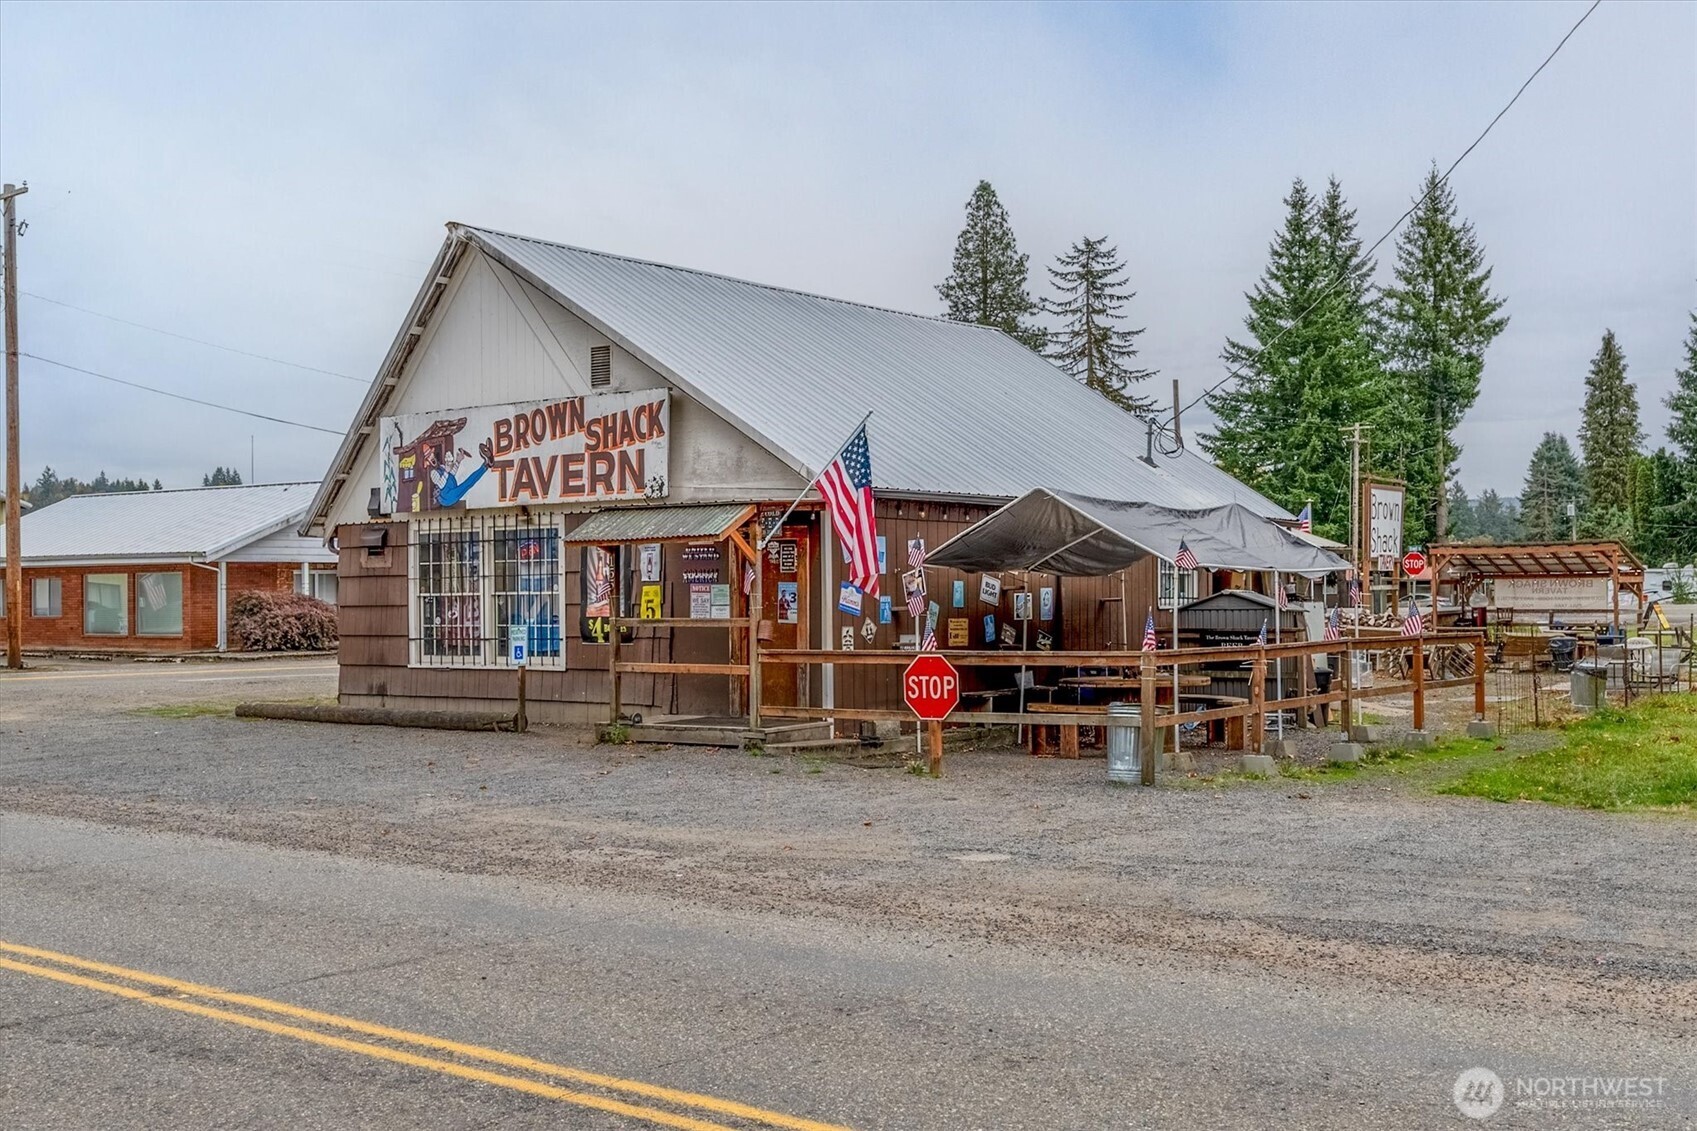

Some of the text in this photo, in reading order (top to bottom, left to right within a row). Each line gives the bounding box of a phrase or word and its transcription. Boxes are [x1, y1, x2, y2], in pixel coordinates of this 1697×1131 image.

[493, 397, 666, 457] BROWN SHACK
[491, 449, 646, 503] TAVERN
[1371, 494, 1400, 522] Brown
[1371, 527, 1399, 554] Shack
[1405, 559, 1424, 569] STOP
[982, 588, 998, 599] LIGHT
[985, 581, 997, 591] BUD
[588, 617, 605, 643] $4
[907, 675, 955, 700] STOP
